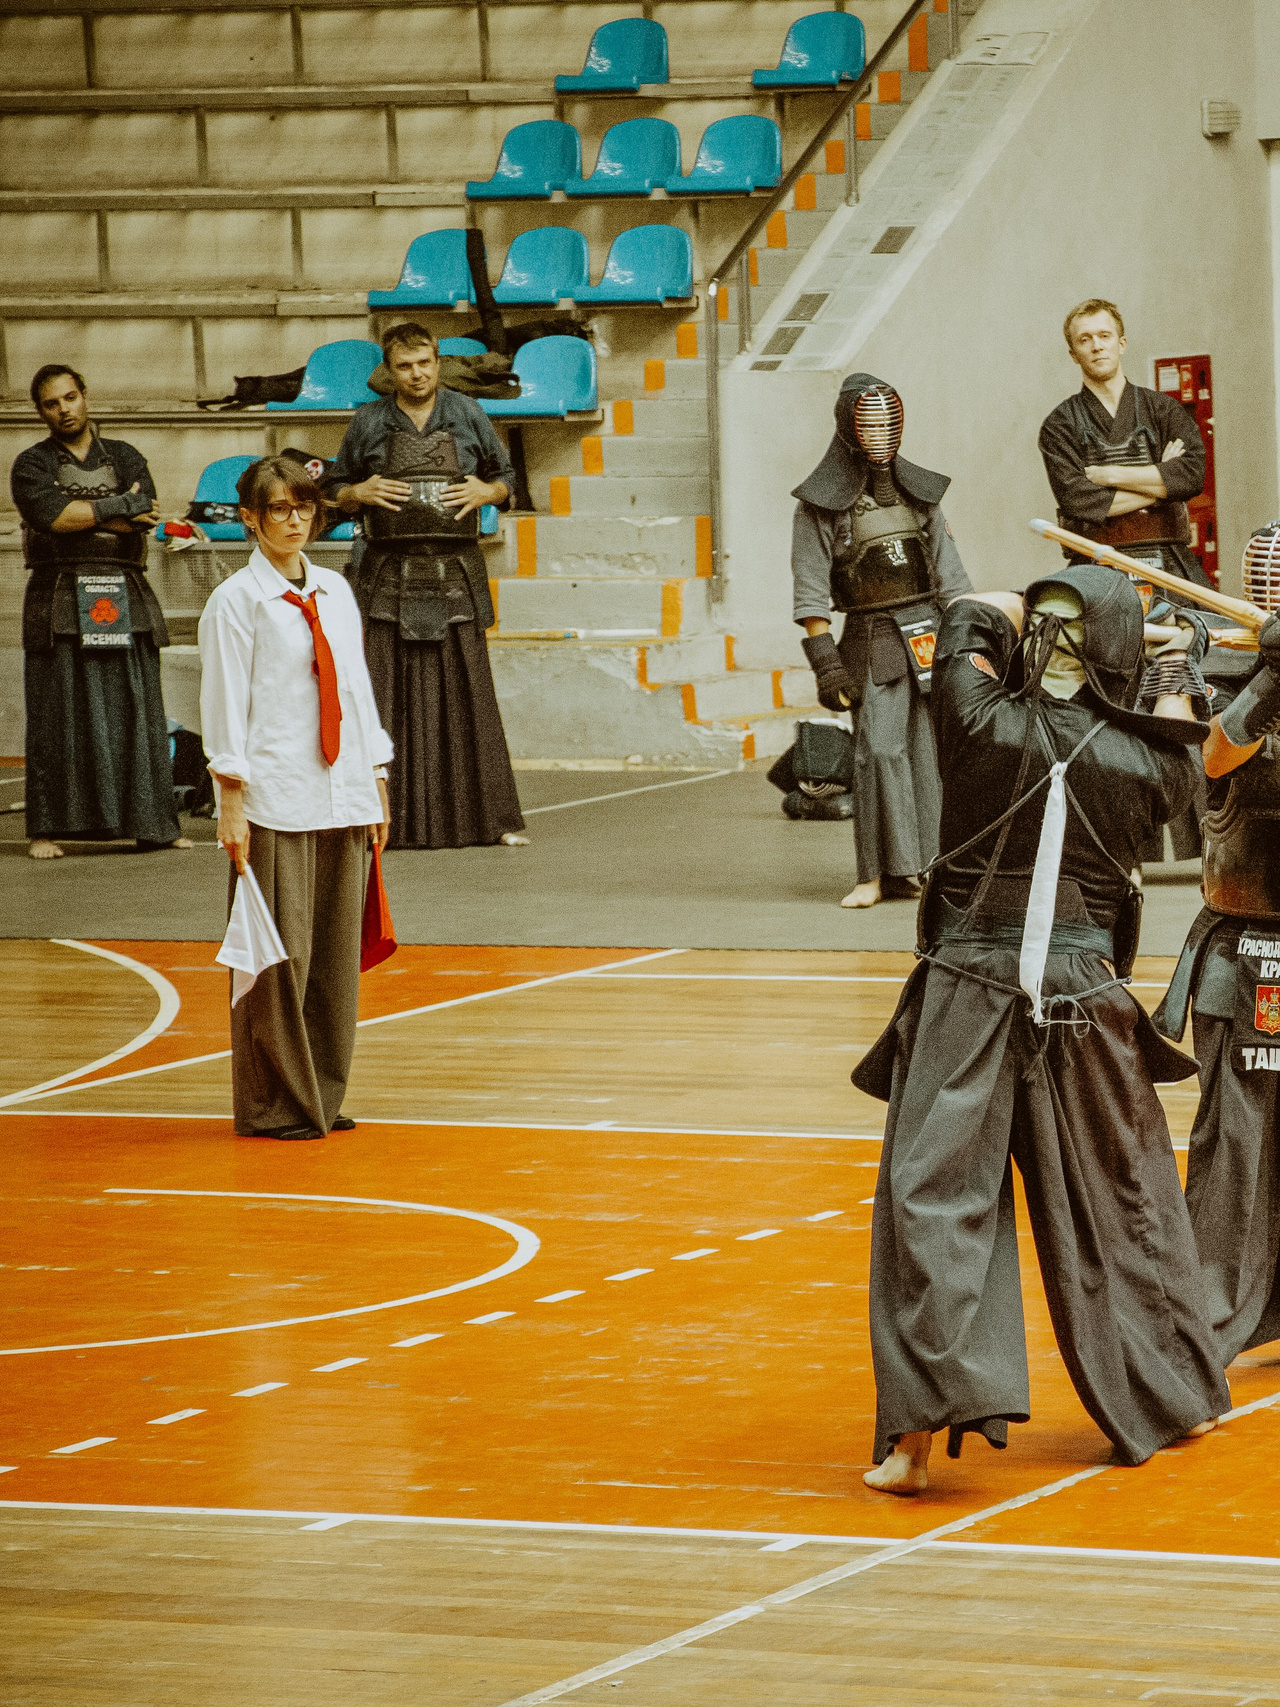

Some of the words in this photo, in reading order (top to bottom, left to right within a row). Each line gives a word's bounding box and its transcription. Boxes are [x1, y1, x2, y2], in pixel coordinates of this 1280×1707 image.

[78, 575, 126, 584] РОСТОВСКАЯ
[85, 585, 120, 593] ОБЛАСТЬ
[82, 633, 131, 645] ЯСЕНИК
